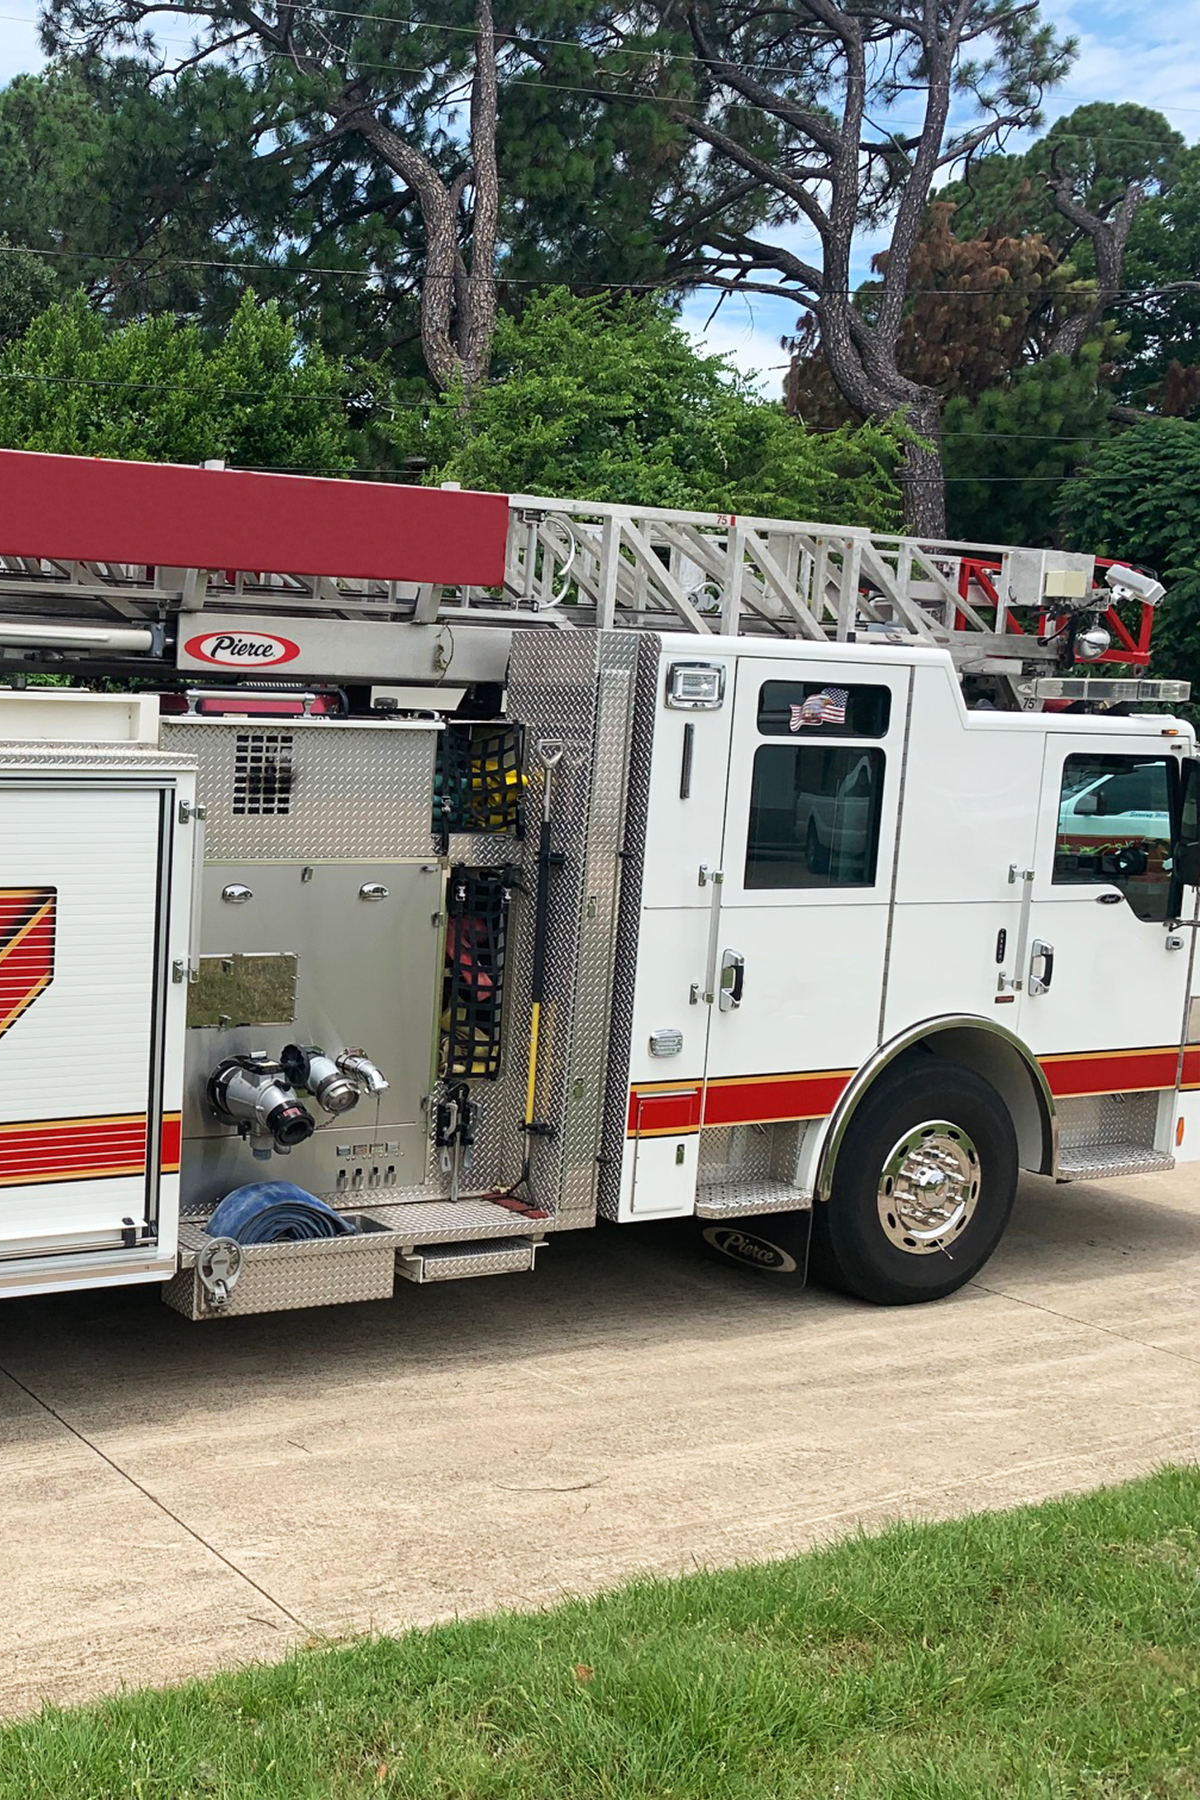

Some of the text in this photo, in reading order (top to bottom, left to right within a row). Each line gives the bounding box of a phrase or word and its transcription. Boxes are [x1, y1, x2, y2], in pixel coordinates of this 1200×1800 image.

[717, 515, 728, 525] 75
[210, 635, 275, 658] Pierce
[722, 1232, 775, 1263] Pierce
